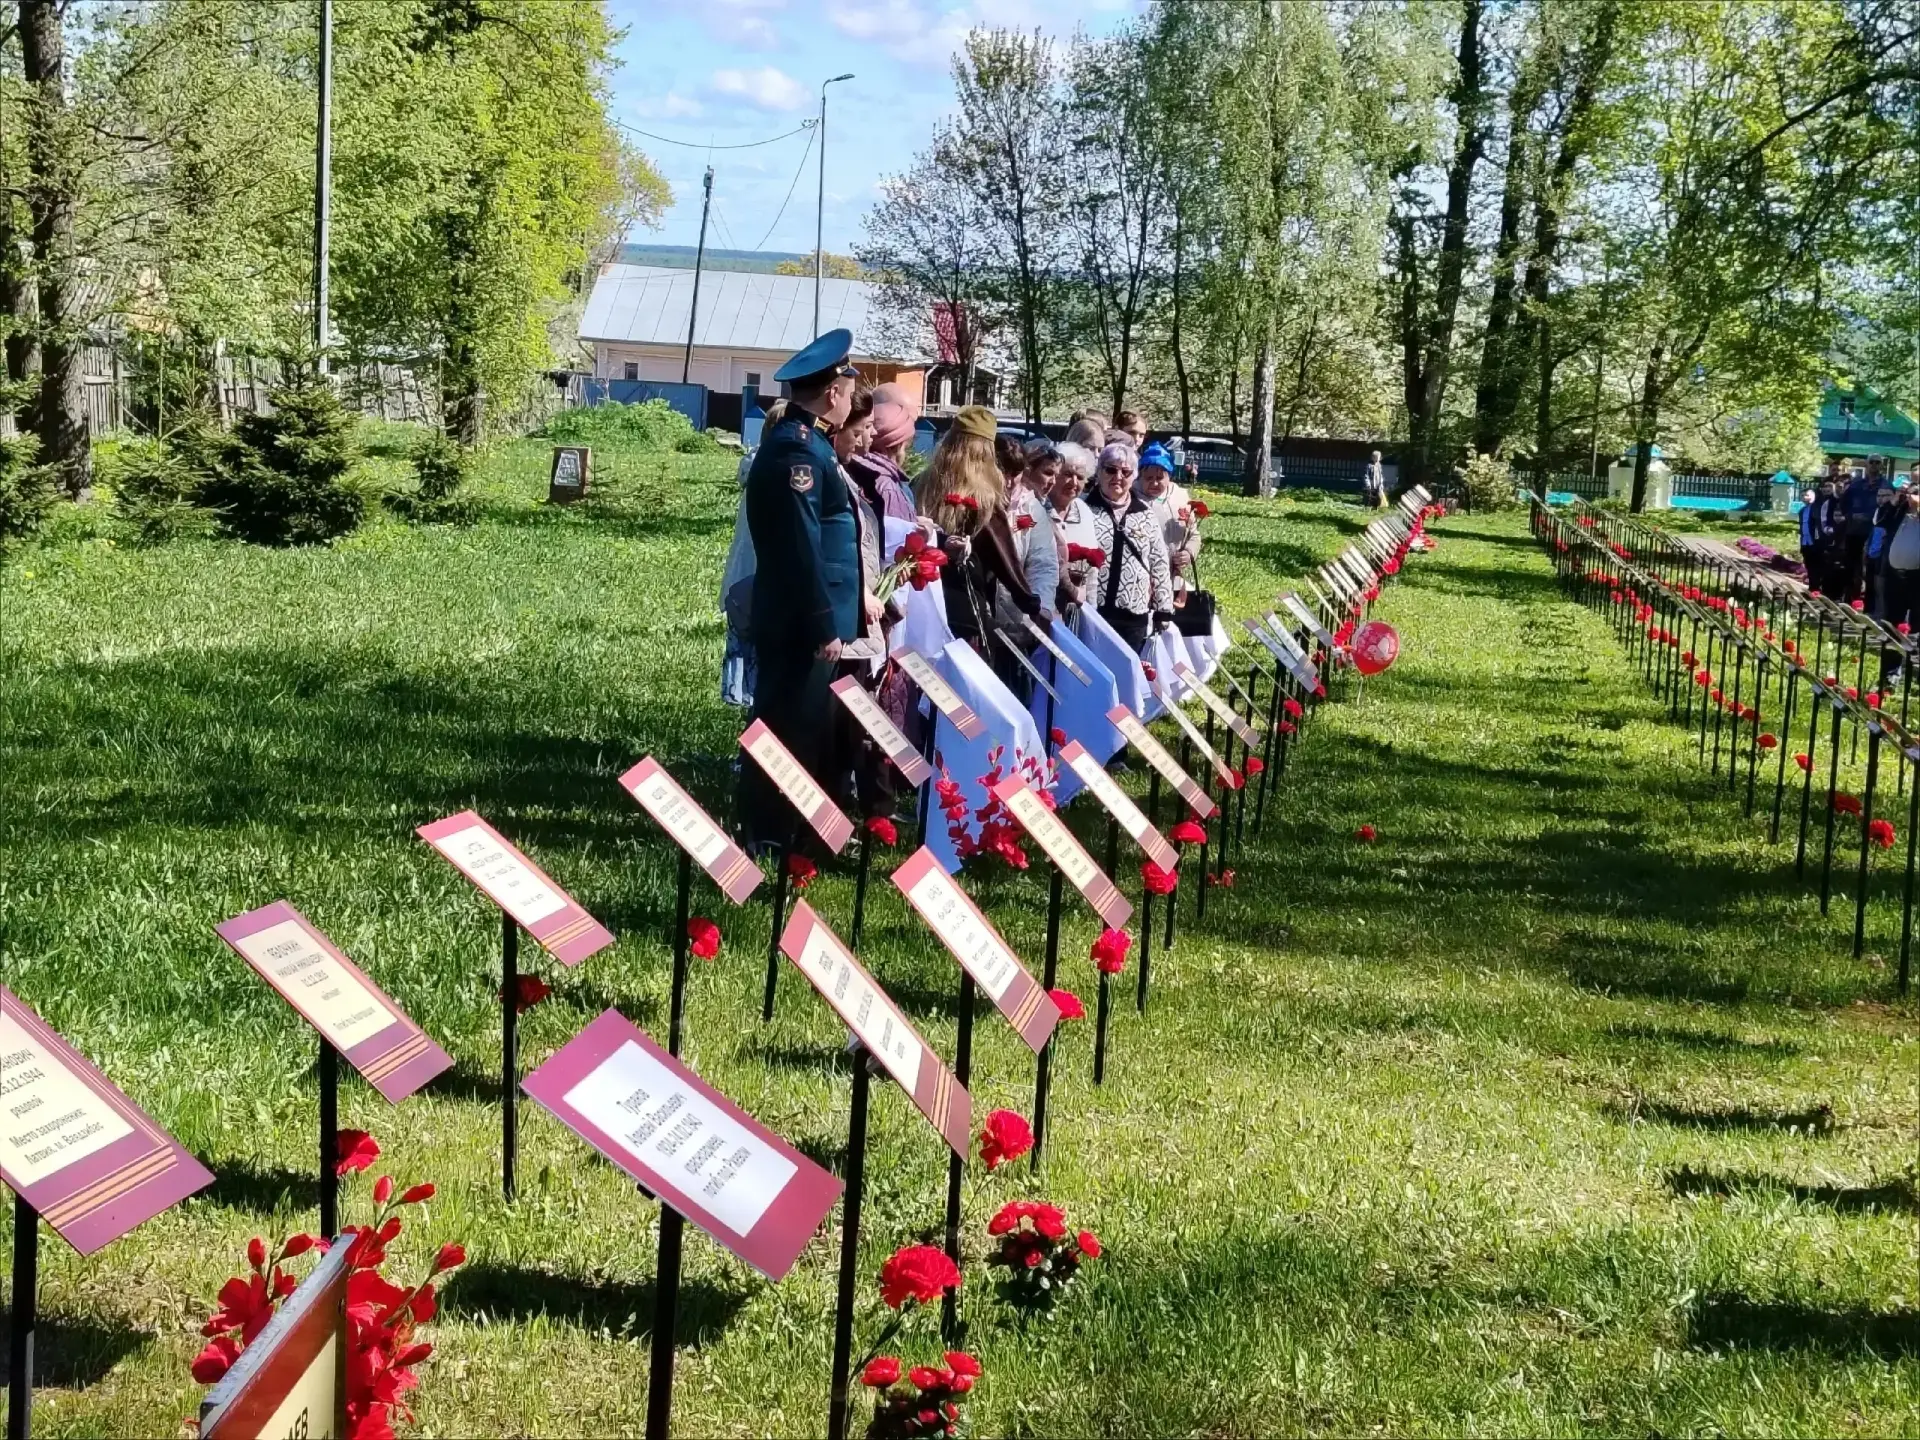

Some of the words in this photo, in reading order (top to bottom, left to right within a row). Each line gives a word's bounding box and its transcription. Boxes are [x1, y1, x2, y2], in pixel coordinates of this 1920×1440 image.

[9, 1094, 45, 1119] рядовой
[624, 1117, 658, 1148] Алексей
[646, 1091, 688, 1127] Васильевич
[9, 1128, 40, 1149] Место
[36, 1108, 87, 1135] захоронения:
